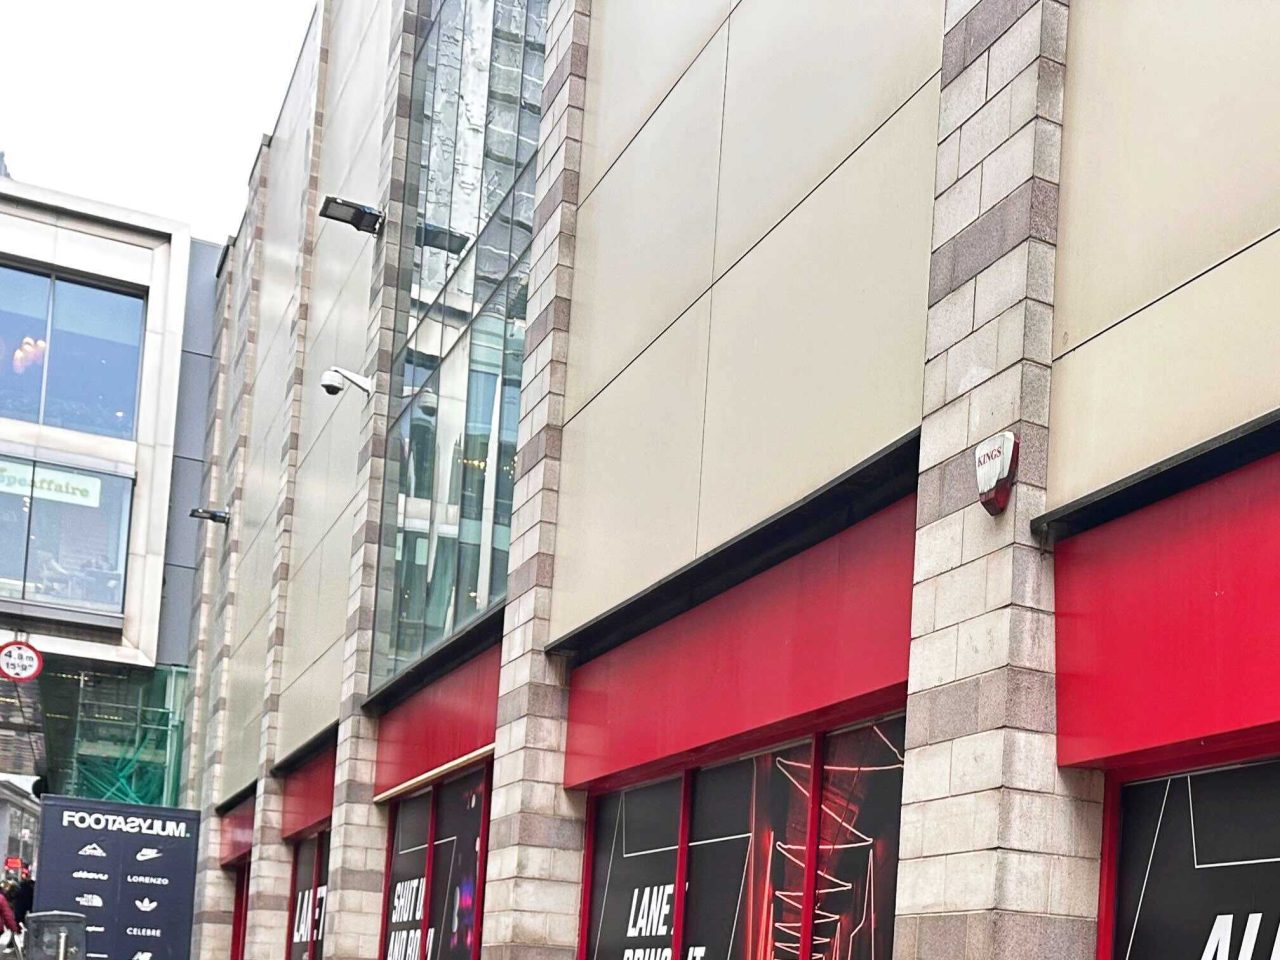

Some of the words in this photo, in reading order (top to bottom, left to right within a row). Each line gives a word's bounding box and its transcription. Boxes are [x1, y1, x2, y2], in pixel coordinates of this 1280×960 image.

[977, 446, 1002, 467] KINGS
[127, 875, 169, 885] LORENZO
[392, 879, 419, 923] SHUT
[415, 878, 426, 921] U
[626, 882, 689, 937] LANE
[126, 927, 161, 937] CELEBRE
